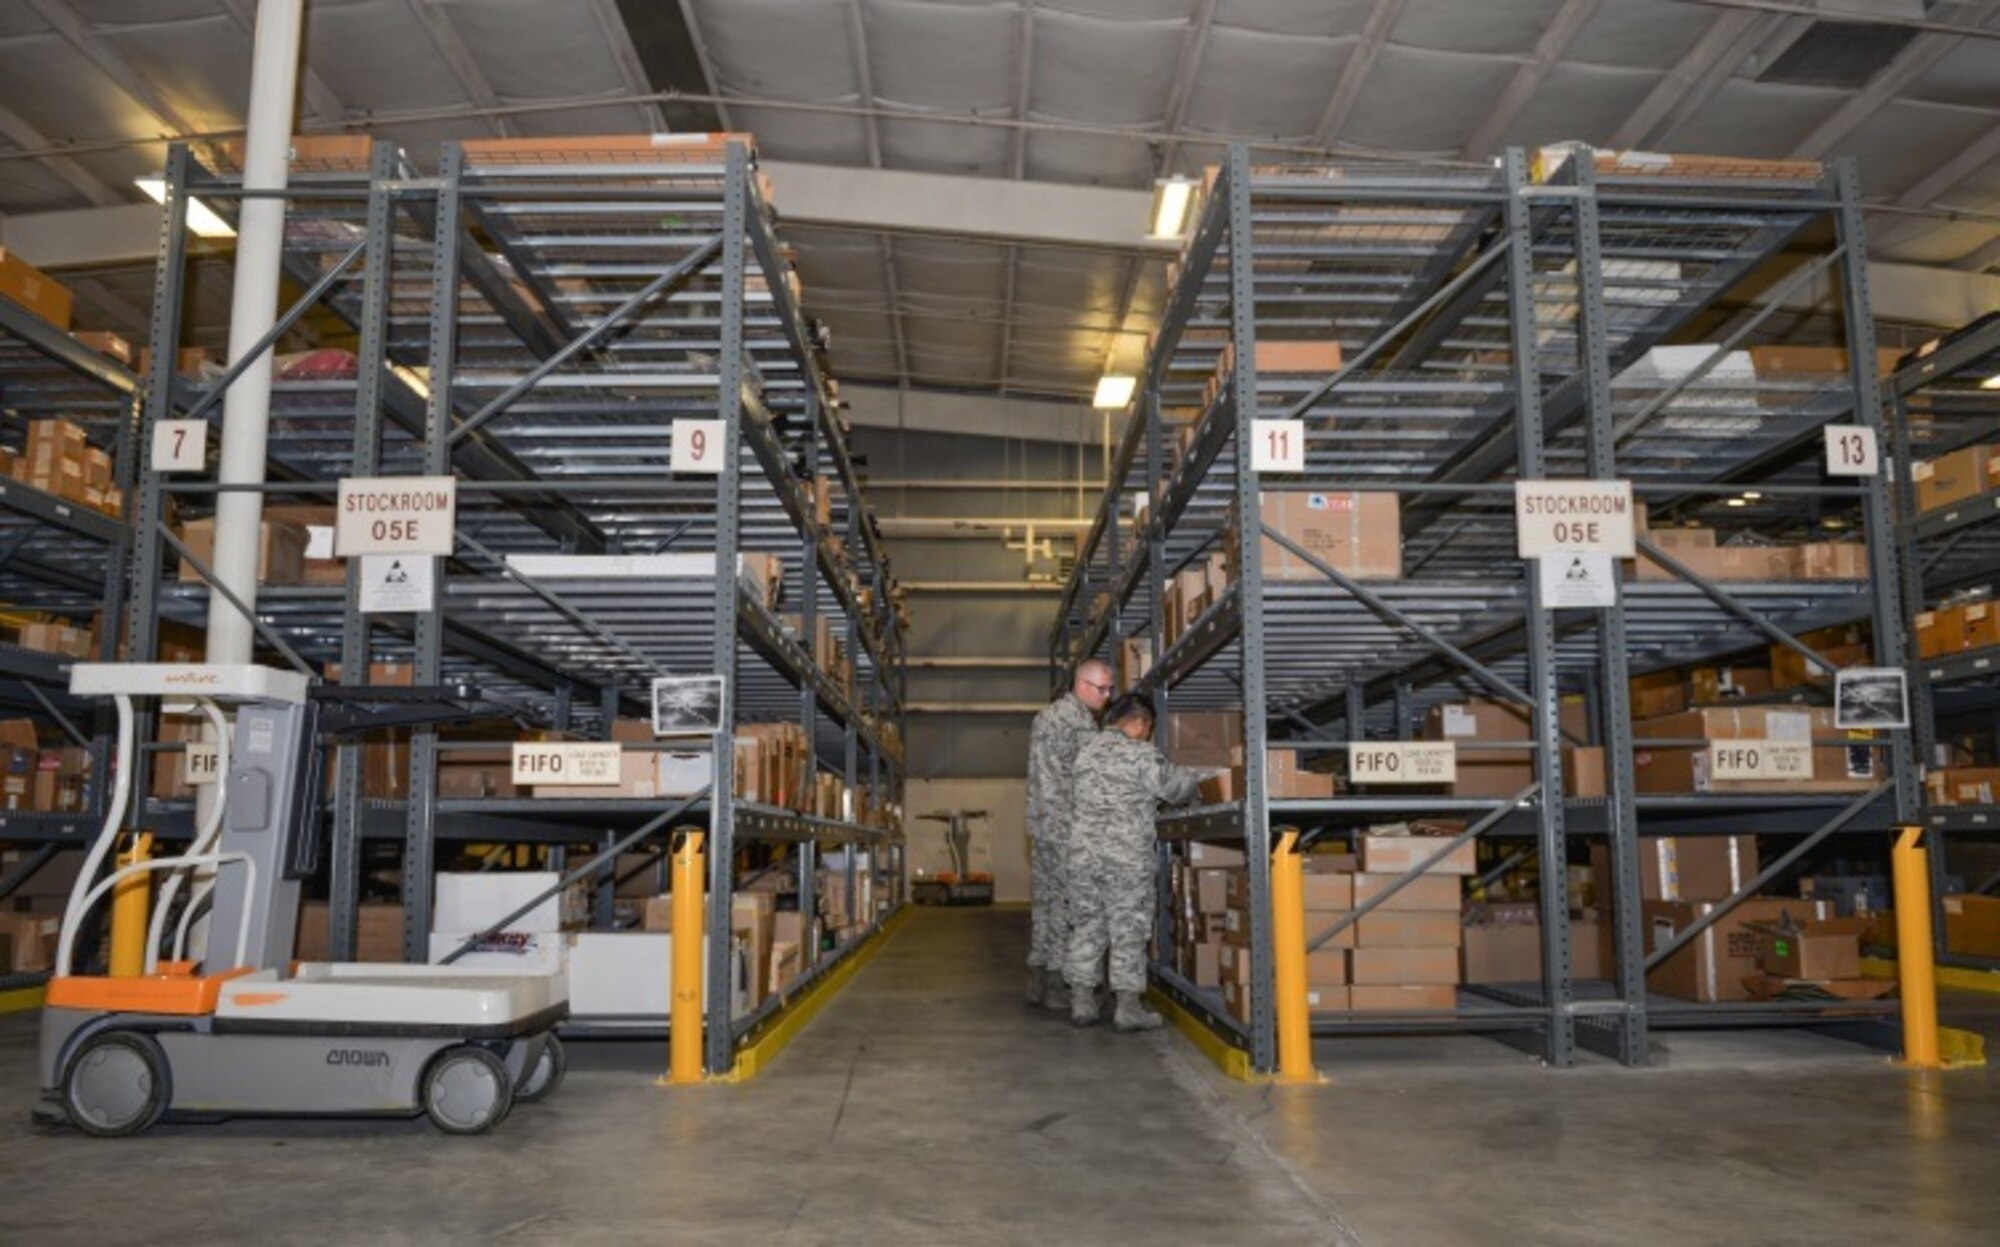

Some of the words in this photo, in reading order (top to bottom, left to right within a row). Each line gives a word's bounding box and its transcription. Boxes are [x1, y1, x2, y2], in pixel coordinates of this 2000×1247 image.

[174, 429, 186, 460] 7
[691, 429, 705, 461] 9
[1268, 430, 1288, 460] 11
[1840, 434, 1865, 465] 13
[345, 492, 448, 511] STOCKROOM
[1525, 494, 1626, 514] STOCKROOM
[518, 754, 562, 772] FIFO
[1356, 752, 1399, 772] FIFO
[1717, 749, 1759, 769] FIFO
